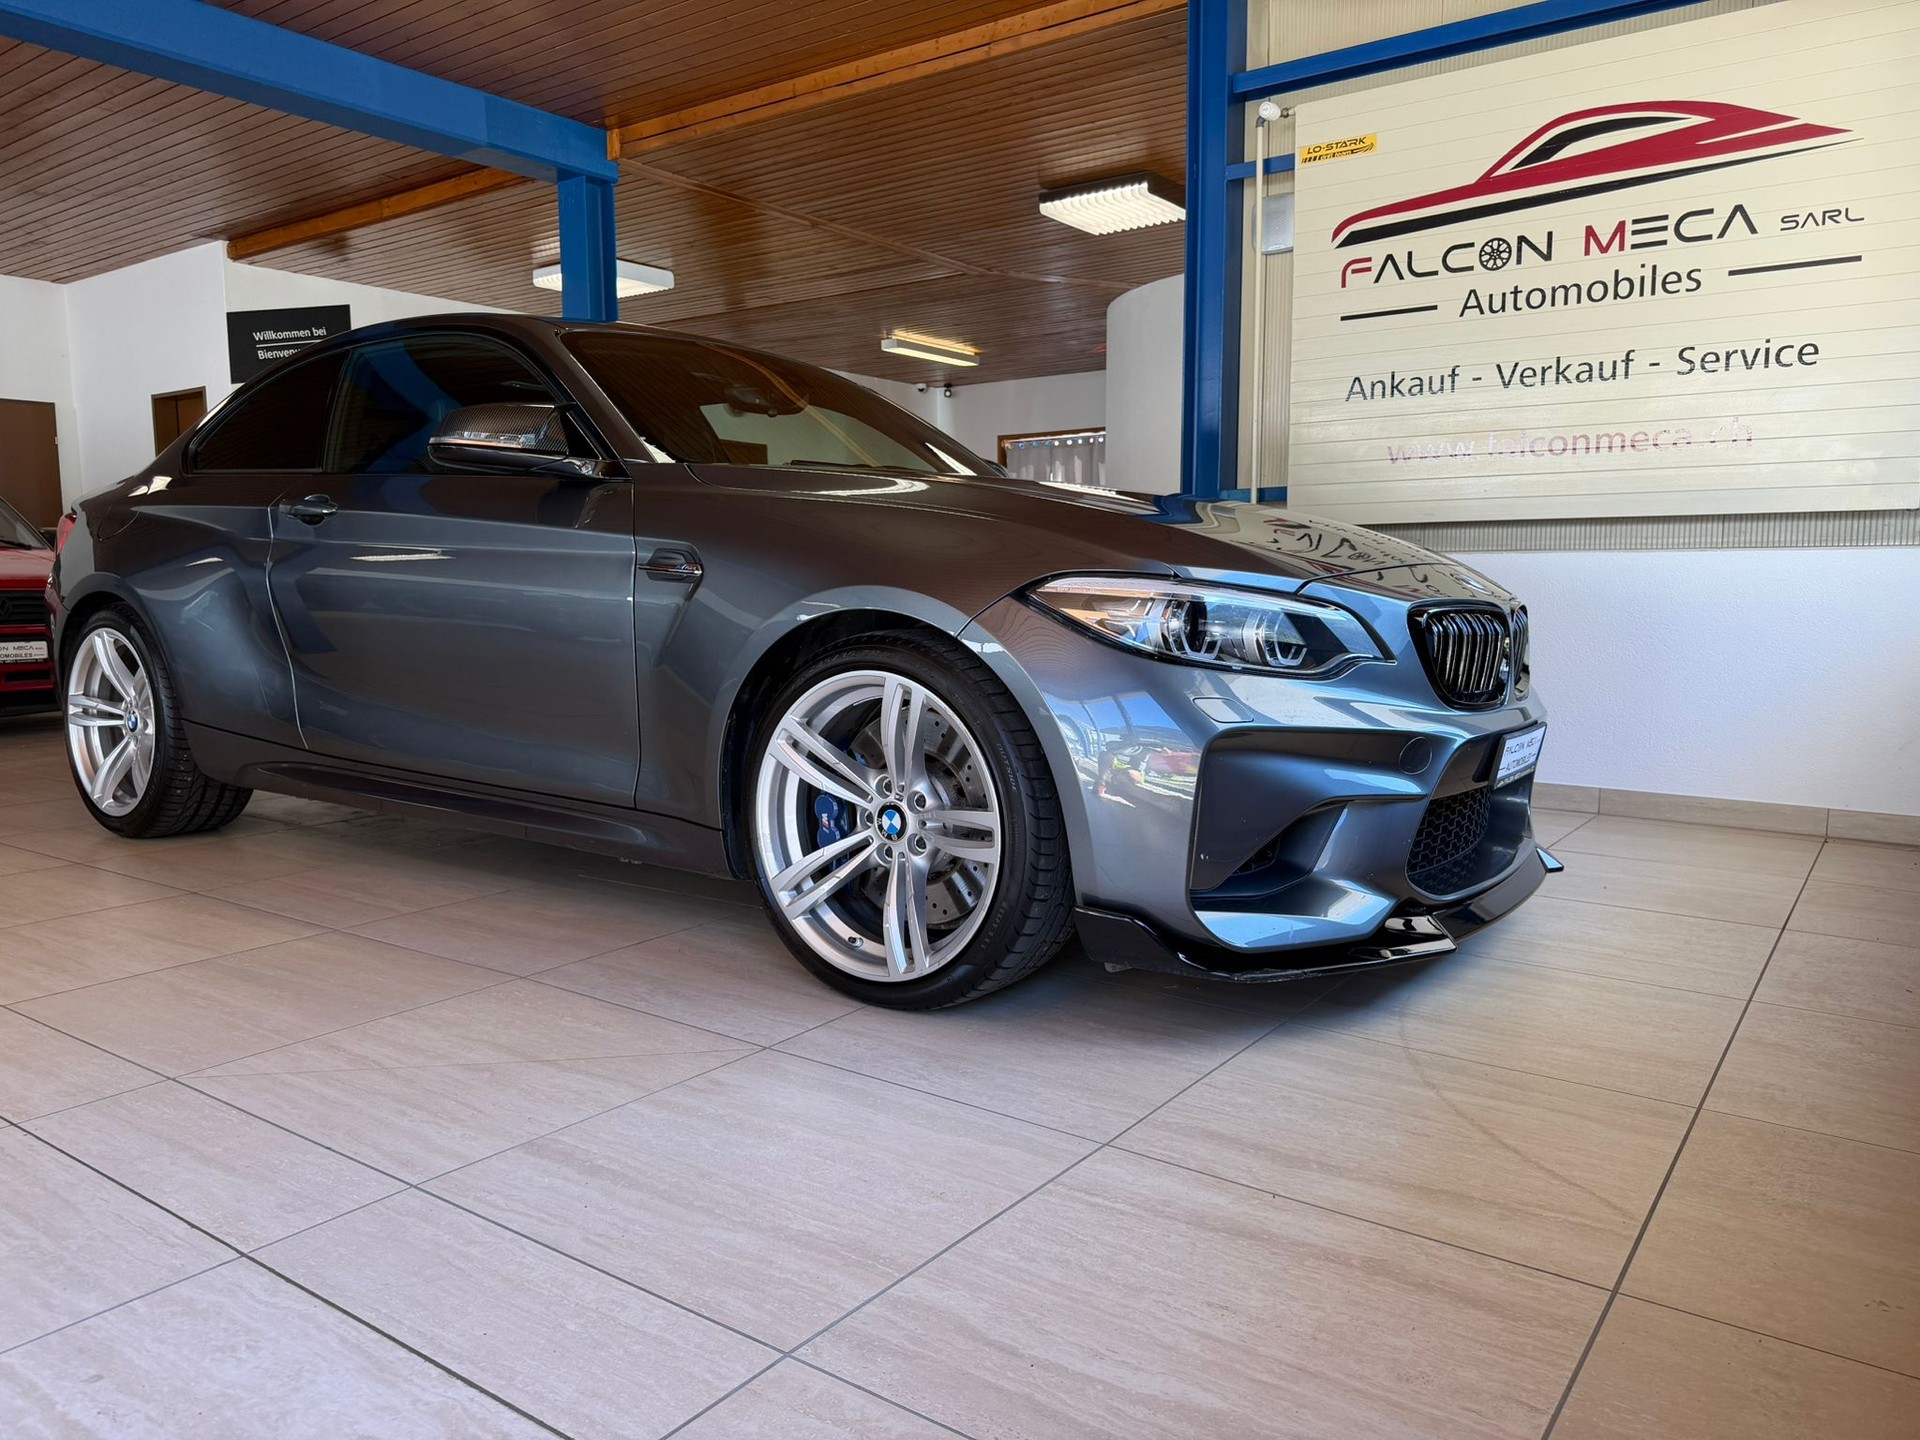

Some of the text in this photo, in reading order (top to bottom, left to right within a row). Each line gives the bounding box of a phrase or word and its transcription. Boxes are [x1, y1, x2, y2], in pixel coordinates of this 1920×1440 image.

[1307, 136, 1367, 155] LO-STARK
[1340, 203, 1865, 289] FALCON MECA SARL
[1458, 263, 1702, 318] Automobiles
[253, 326, 327, 341] Willkommen bei
[257, 349, 300, 360] Bienven
[1344, 364, 1461, 402] Ankauf
[1495, 349, 1636, 390] Verkauf
[1676, 337, 1820, 376] Service
